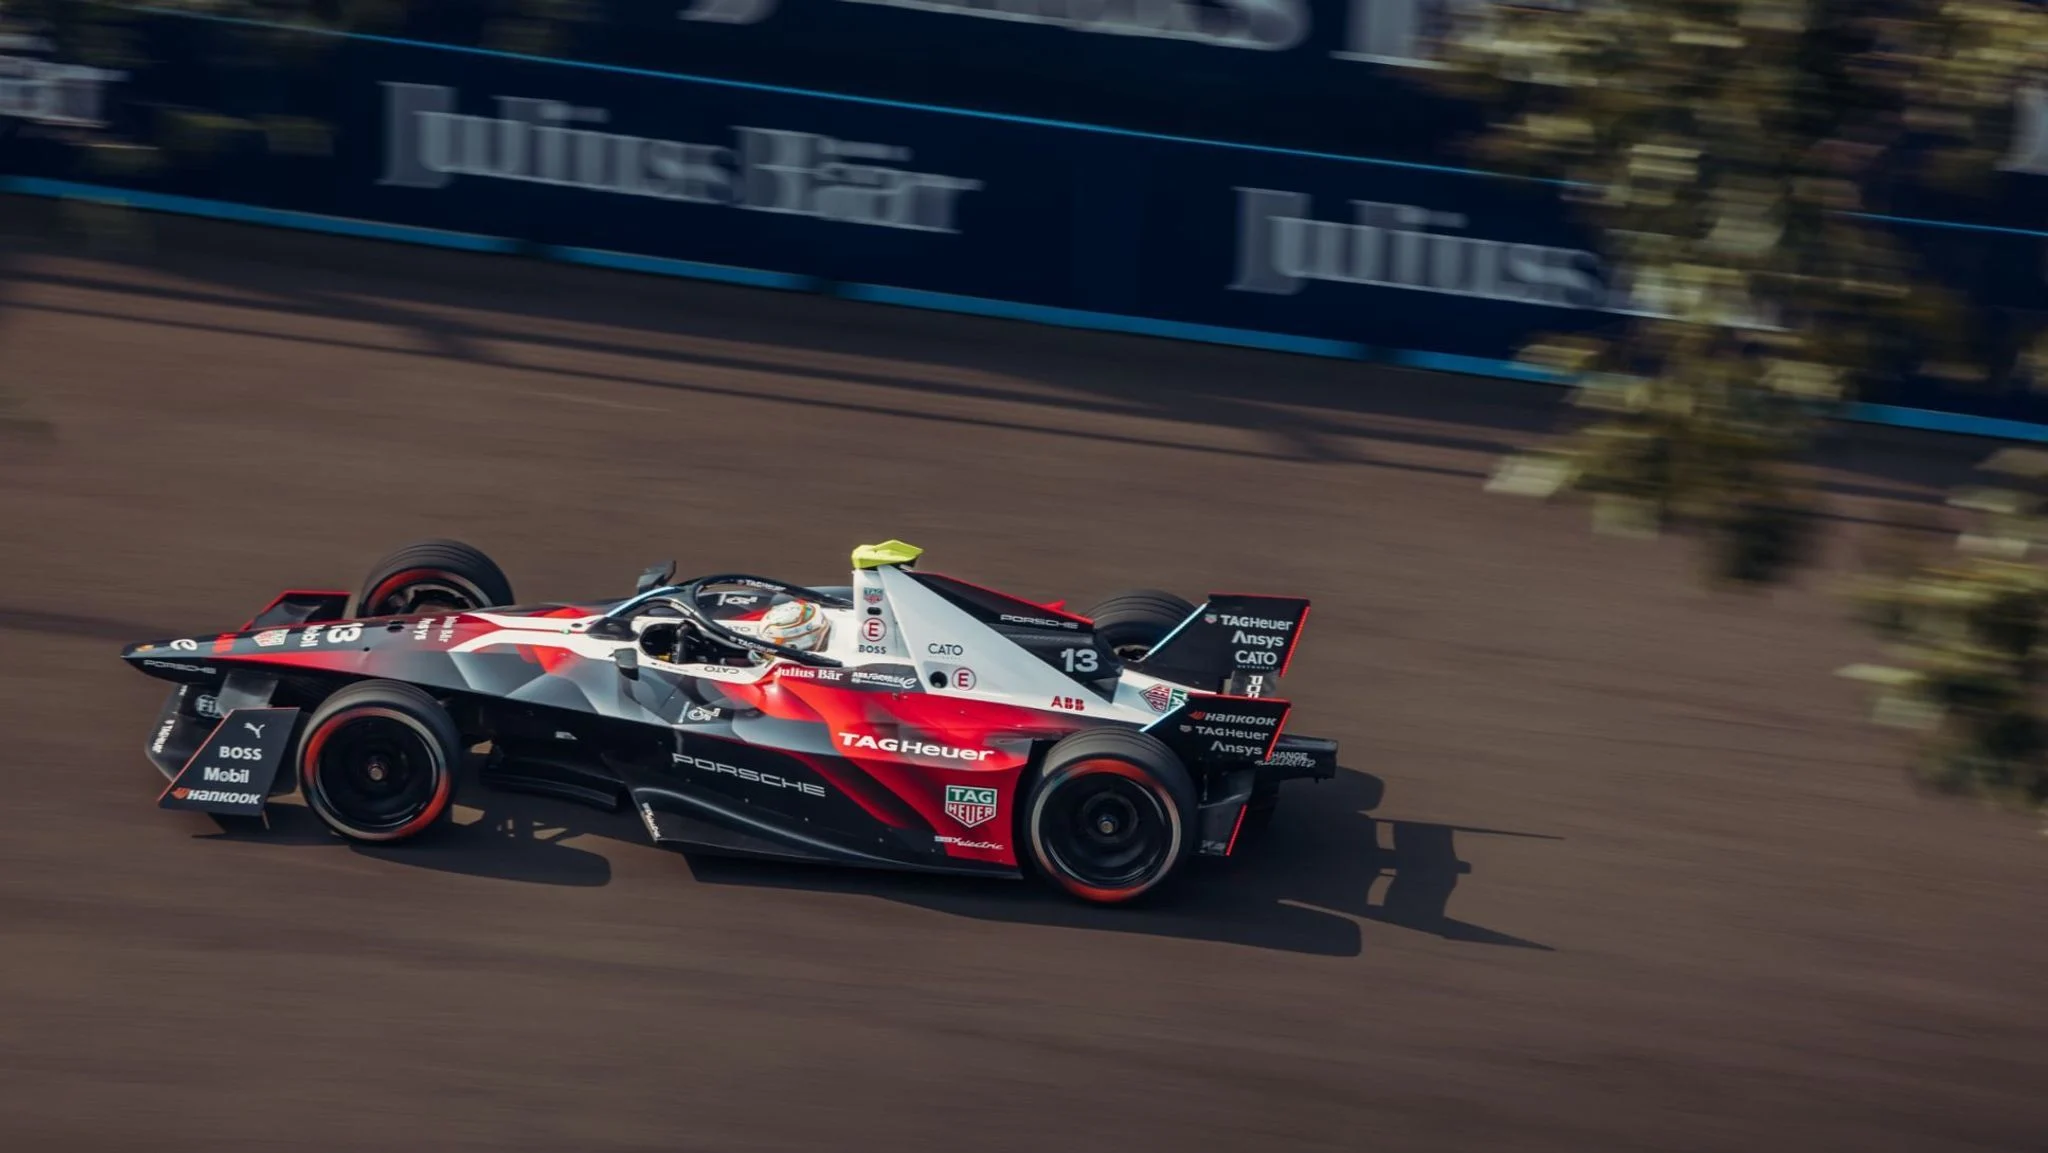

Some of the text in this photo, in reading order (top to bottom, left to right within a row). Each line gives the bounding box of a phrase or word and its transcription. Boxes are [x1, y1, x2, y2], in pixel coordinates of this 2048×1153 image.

[373, 80, 986, 235] Julius Bär
[1224, 185, 1604, 311] Julius
[1000, 614, 1078, 629] PORSCHE
[1220, 614, 1293, 631] TAGHeuer
[1231, 629, 1285, 649] Ansys
[858, 644, 887, 655] BOSS
[928, 643, 964, 656] CATO
[1234, 650, 1278, 666] CATO
[144, 658, 217, 675] PORSCHE
[1060, 648, 1099, 673] 13
[703, 664, 740, 675] CATO
[817, 668, 843, 681] Bär
[1051, 695, 1085, 711] ABB
[219, 745, 262, 760] BOSS
[1210, 740, 1263, 757] Ansys
[203, 766, 250, 783] Mobil
[672, 752, 826, 797] PORSCHE
[951, 788, 993, 804] TAG
[949, 803, 993, 824] HEUER
